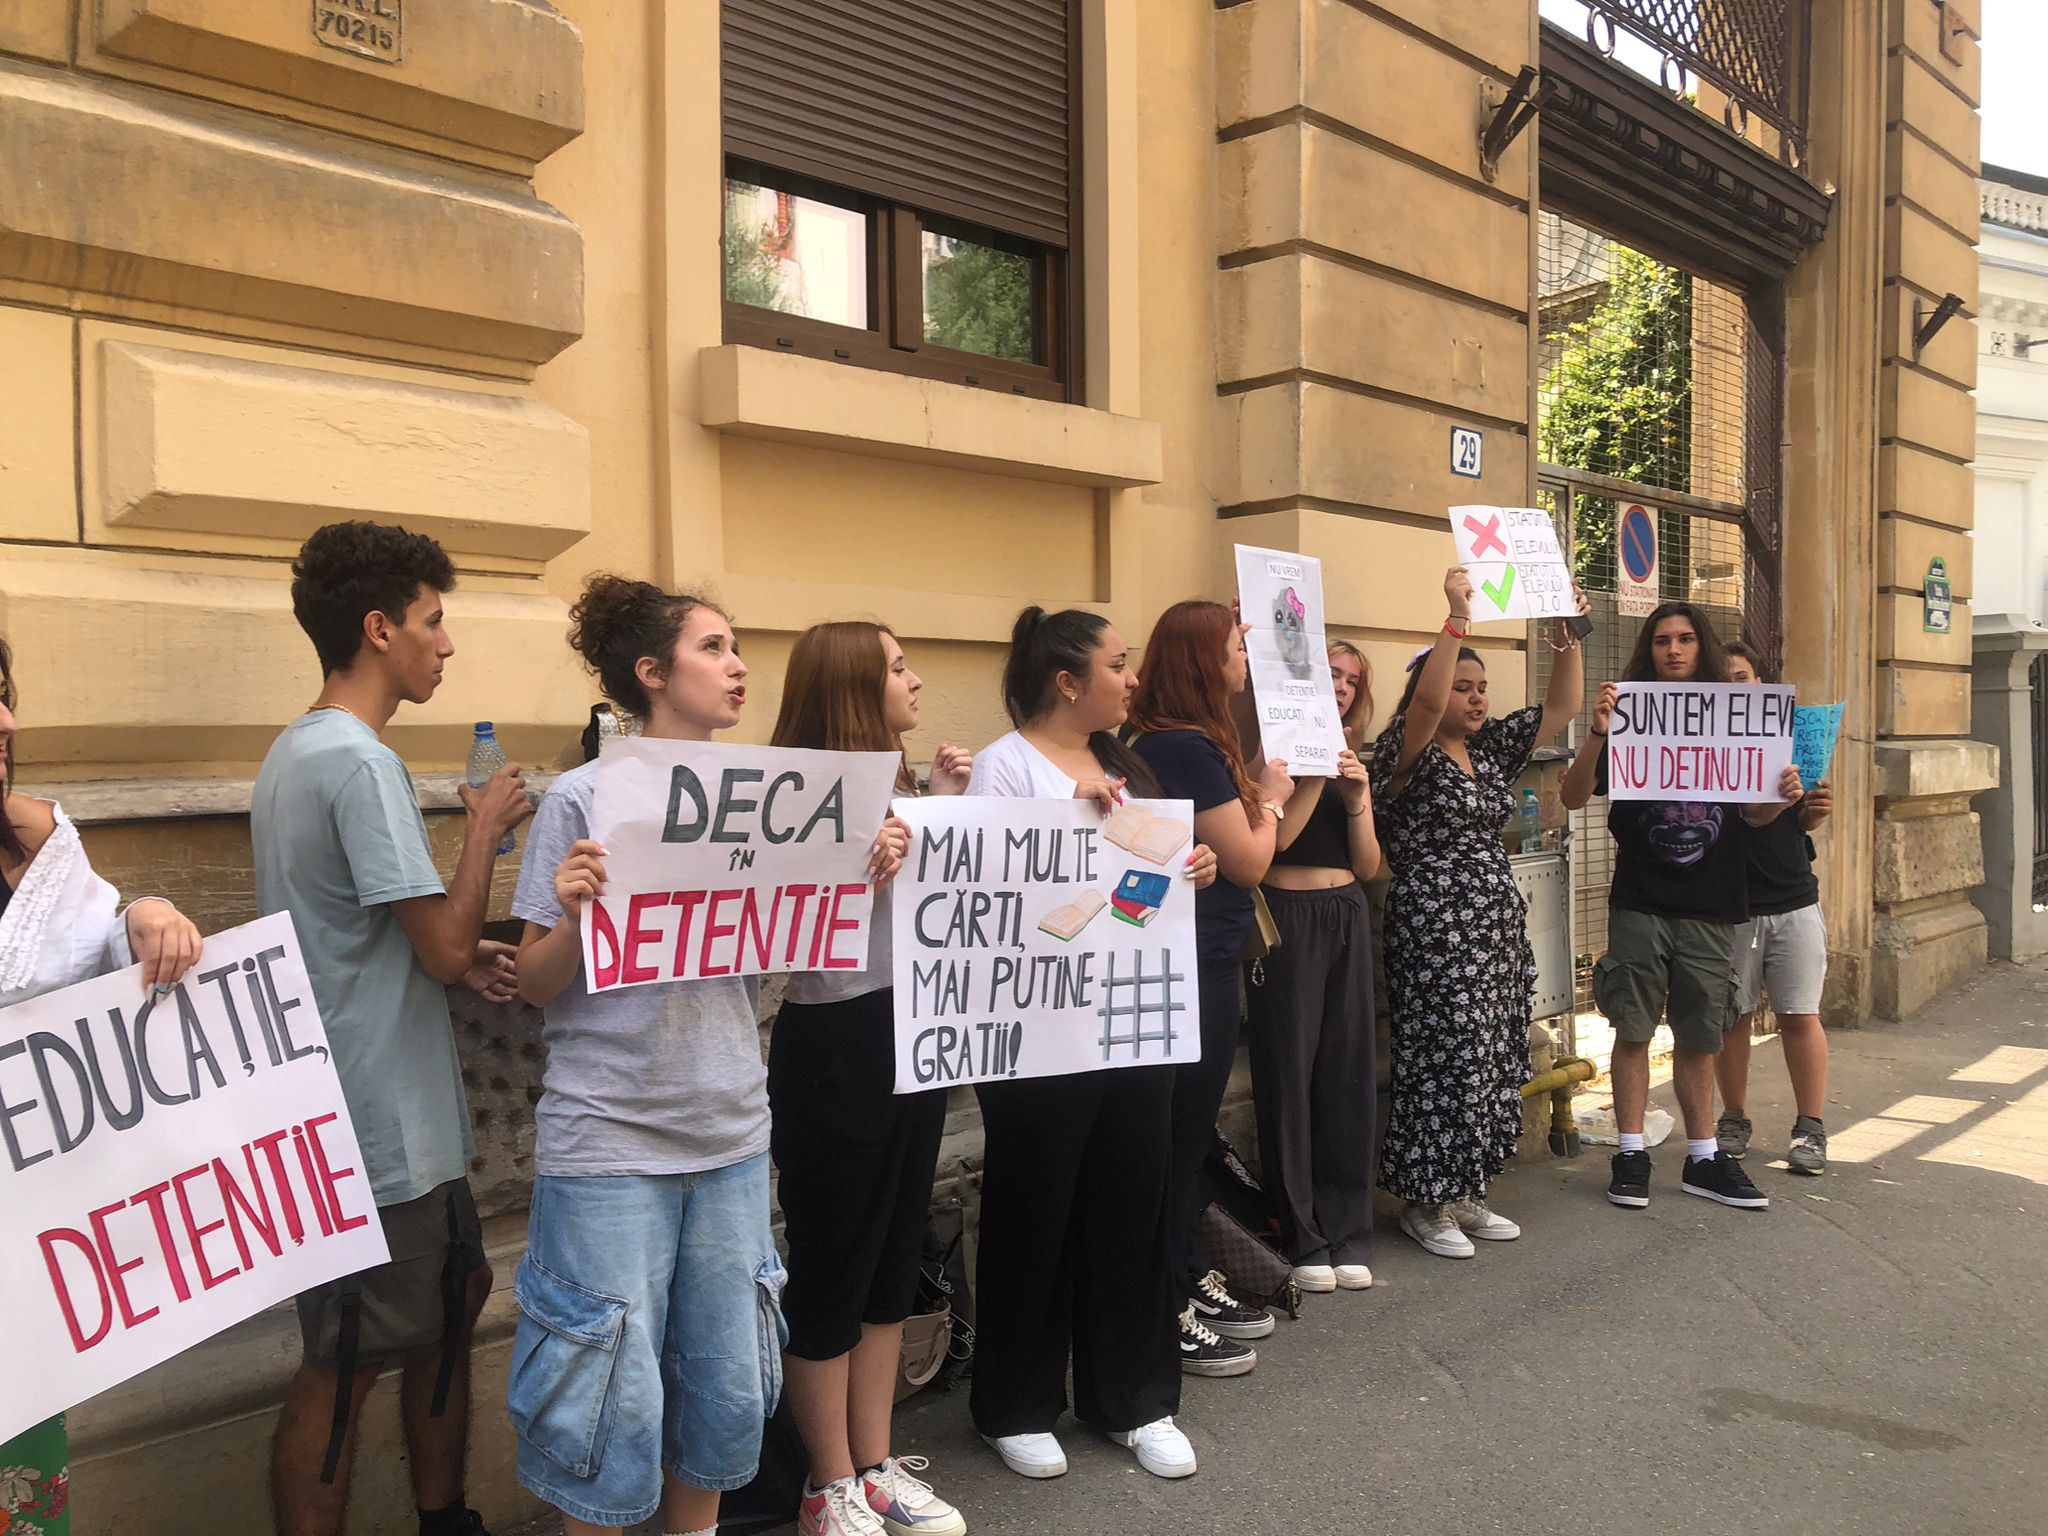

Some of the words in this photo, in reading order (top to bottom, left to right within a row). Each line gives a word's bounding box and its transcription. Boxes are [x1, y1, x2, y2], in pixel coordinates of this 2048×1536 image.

[319, 9, 393, 49] 70215
[1459, 434, 1476, 470] 29
[1537, 595, 1560, 612] 2.0
[1612, 692, 1716, 736] SUNTEM
[1728, 693, 1796, 737] ELEVI
[1612, 745, 1649, 789] NU
[661, 764, 844, 844] DECA
[917, 826, 984, 882] MAI
[1003, 828, 1098, 883] MULTE
[912, 959, 971, 1018] MAI
[912, 1021, 1023, 1083] GRATII!
[37, 1112, 369, 1354] DETENȚIE
